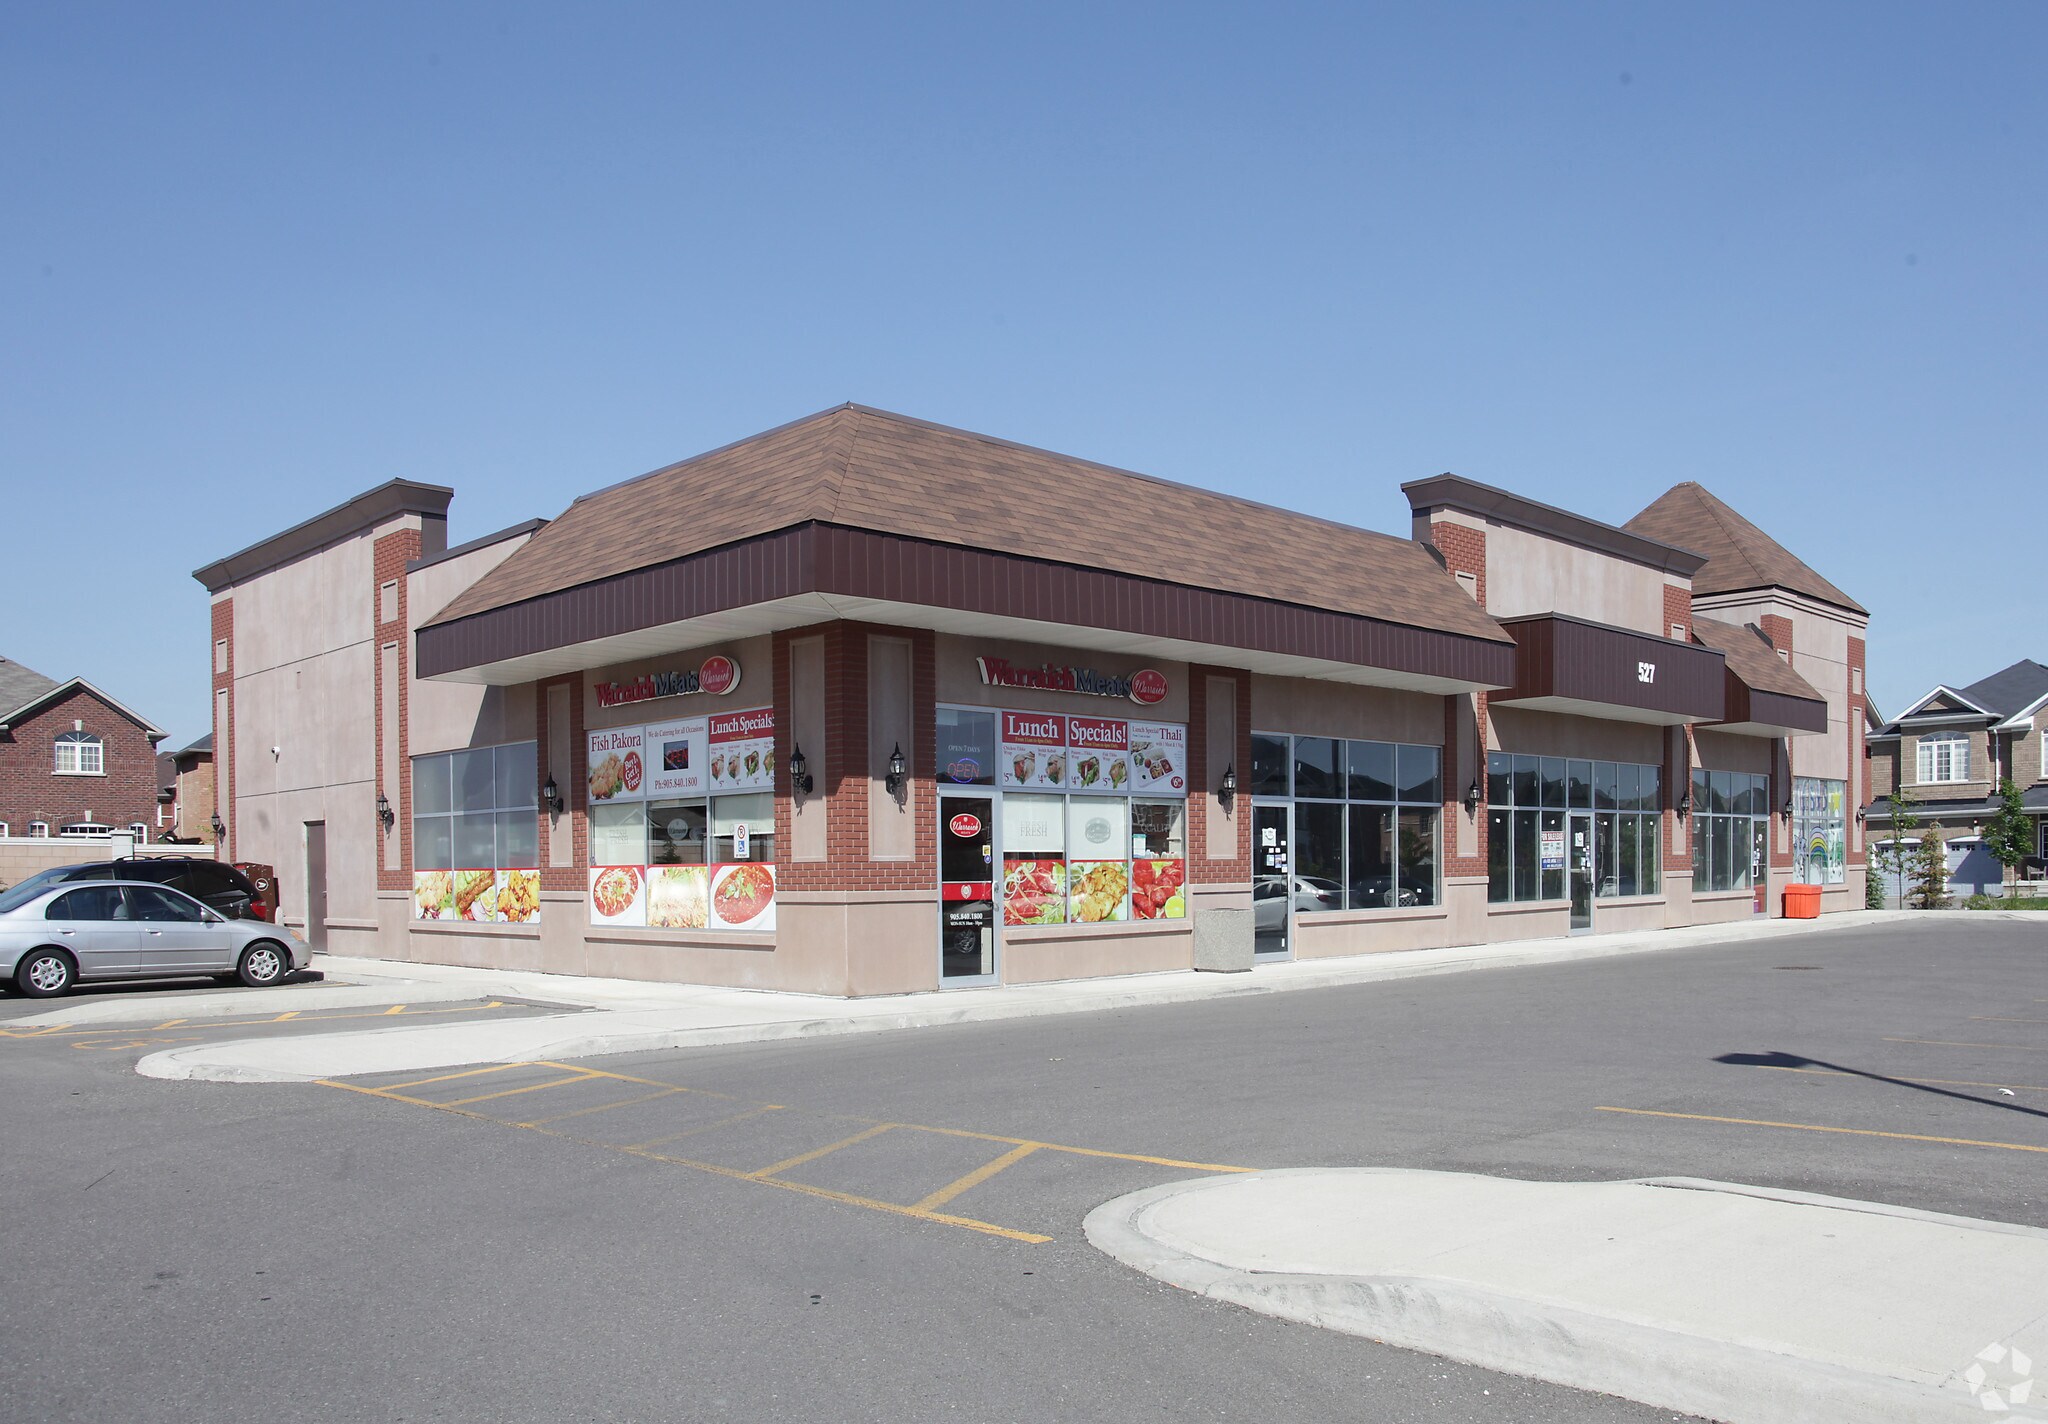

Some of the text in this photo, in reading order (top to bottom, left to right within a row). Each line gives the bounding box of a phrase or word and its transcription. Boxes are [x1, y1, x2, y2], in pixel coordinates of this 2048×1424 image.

[979, 656, 1131, 696] Warraich Meats
[1638, 661, 1656, 684] 527
[594, 670, 700, 707] Warraich Meats
[711, 717, 739, 735] Lunch
[1007, 715, 1127, 745] Lunch Specials!
[1159, 727, 1182, 741] Thali
[591, 733, 642, 752] Fish Pakora
[947, 762, 980, 778] OPEN
[655, 776, 698, 790] Ph:905.840.1800
[1020, 827, 1048, 837] FRESH
[950, 912, 983, 920] 905.840.1800
